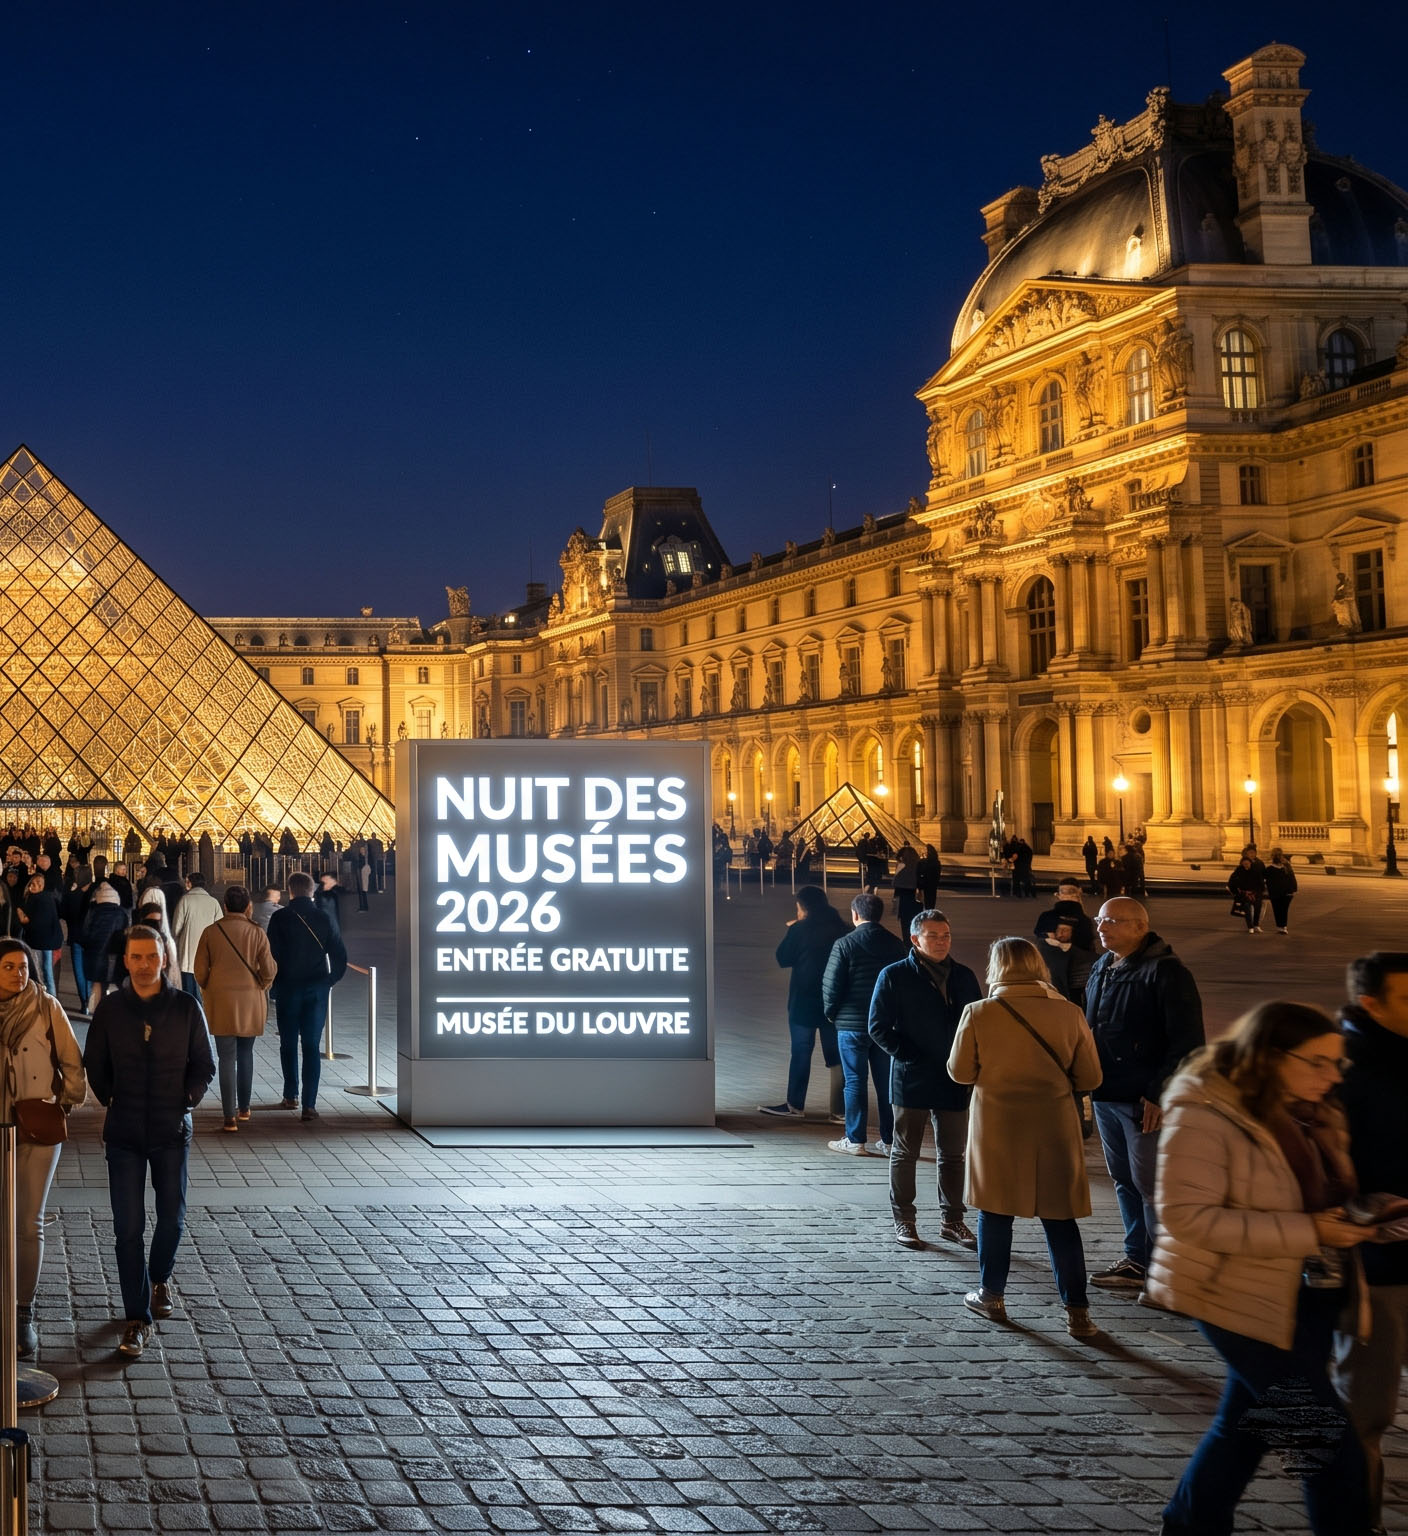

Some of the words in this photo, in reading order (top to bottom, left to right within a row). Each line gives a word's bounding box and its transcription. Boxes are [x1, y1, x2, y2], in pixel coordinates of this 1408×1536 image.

[436, 776, 570, 821] NUIT
[584, 776, 687, 821] DES
[436, 821, 688, 884] MUSÉES
[435, 890, 561, 933] 2026
[436, 943, 544, 972] ENTRÉE
[549, 947, 689, 972] GRATUITE
[436, 1007, 529, 1035] MUSÉE
[535, 1011, 576, 1035] DU
[582, 1011, 690, 1035] LOUVRE
